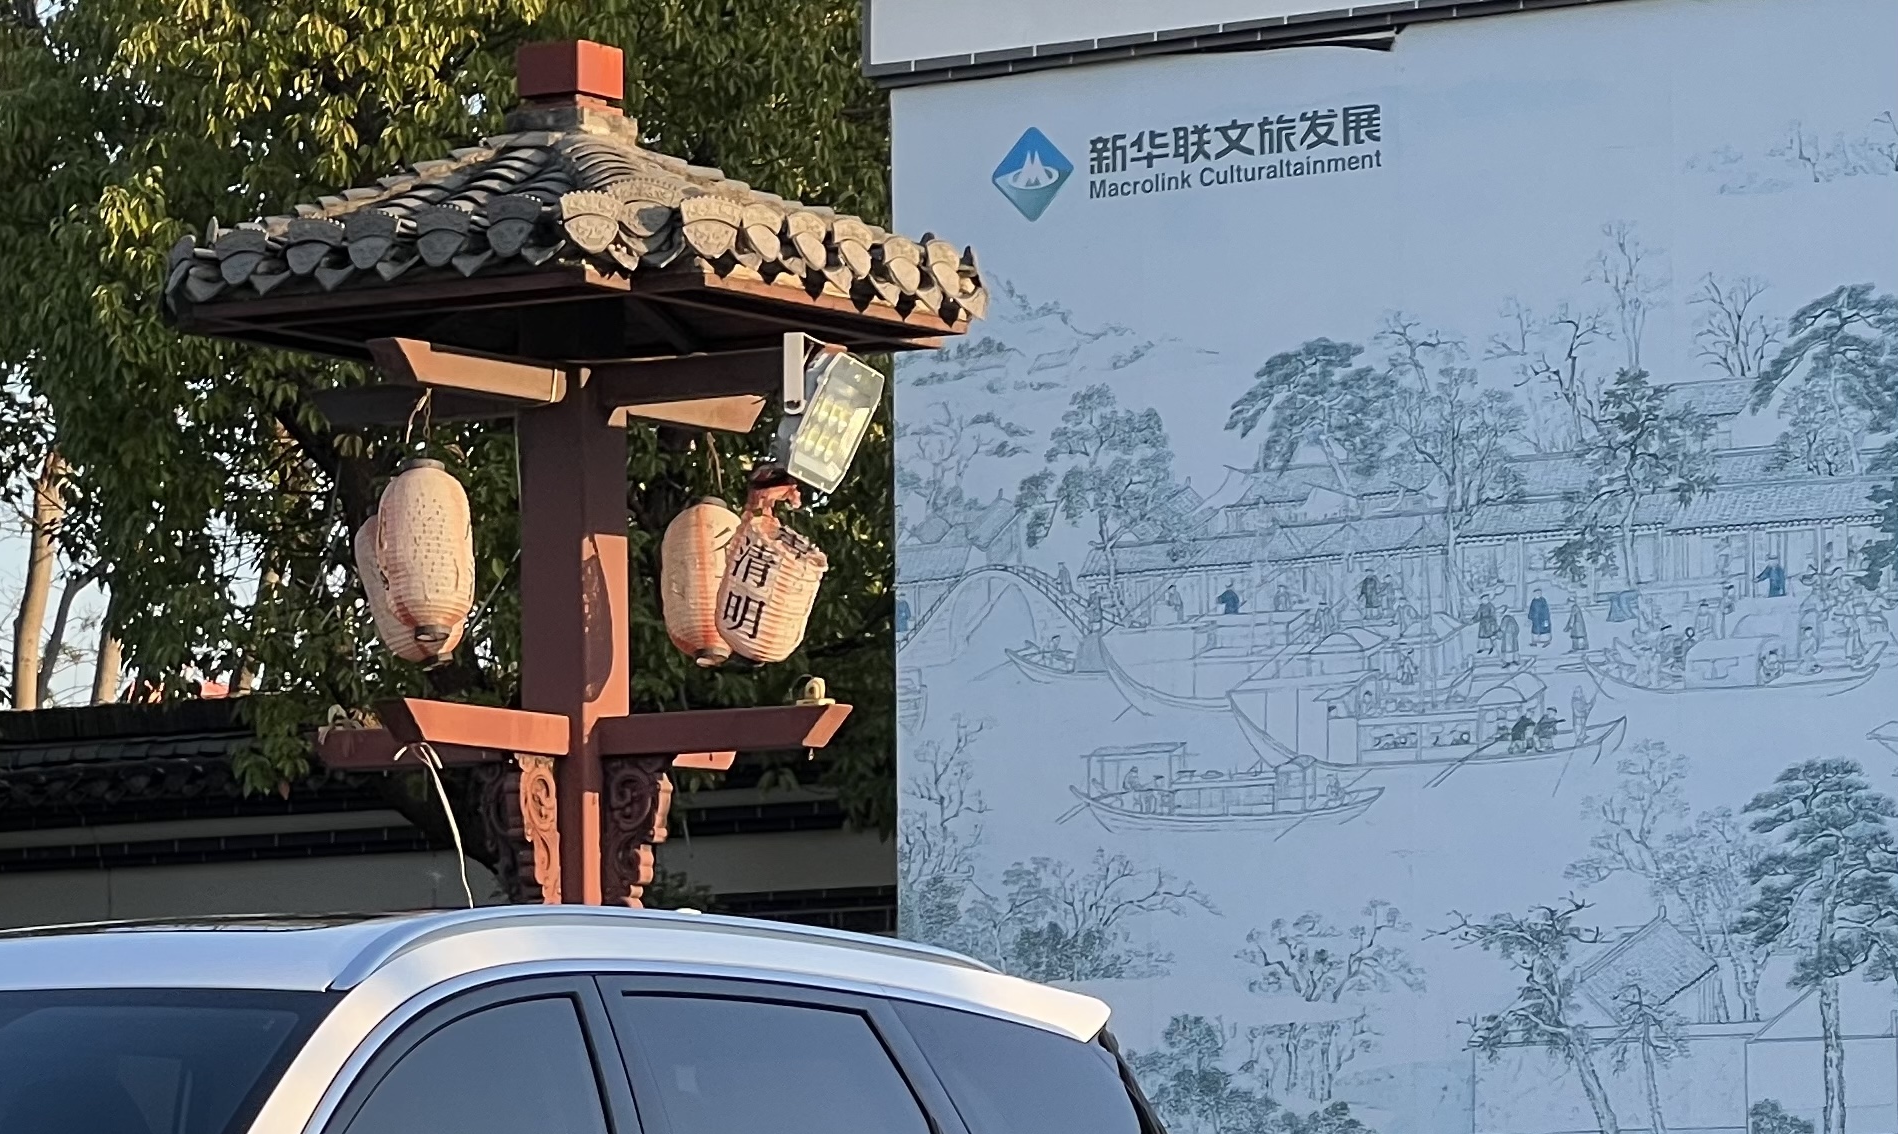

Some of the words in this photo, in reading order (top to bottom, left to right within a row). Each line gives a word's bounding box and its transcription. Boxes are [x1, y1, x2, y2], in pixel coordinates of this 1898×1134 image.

[1089, 104, 1381, 175] 新华联文旅发展
[1089, 170, 1192, 199] Macrolink
[1200, 150, 1383, 187] Culturaltainment
[722, 536, 776, 639] 清明
